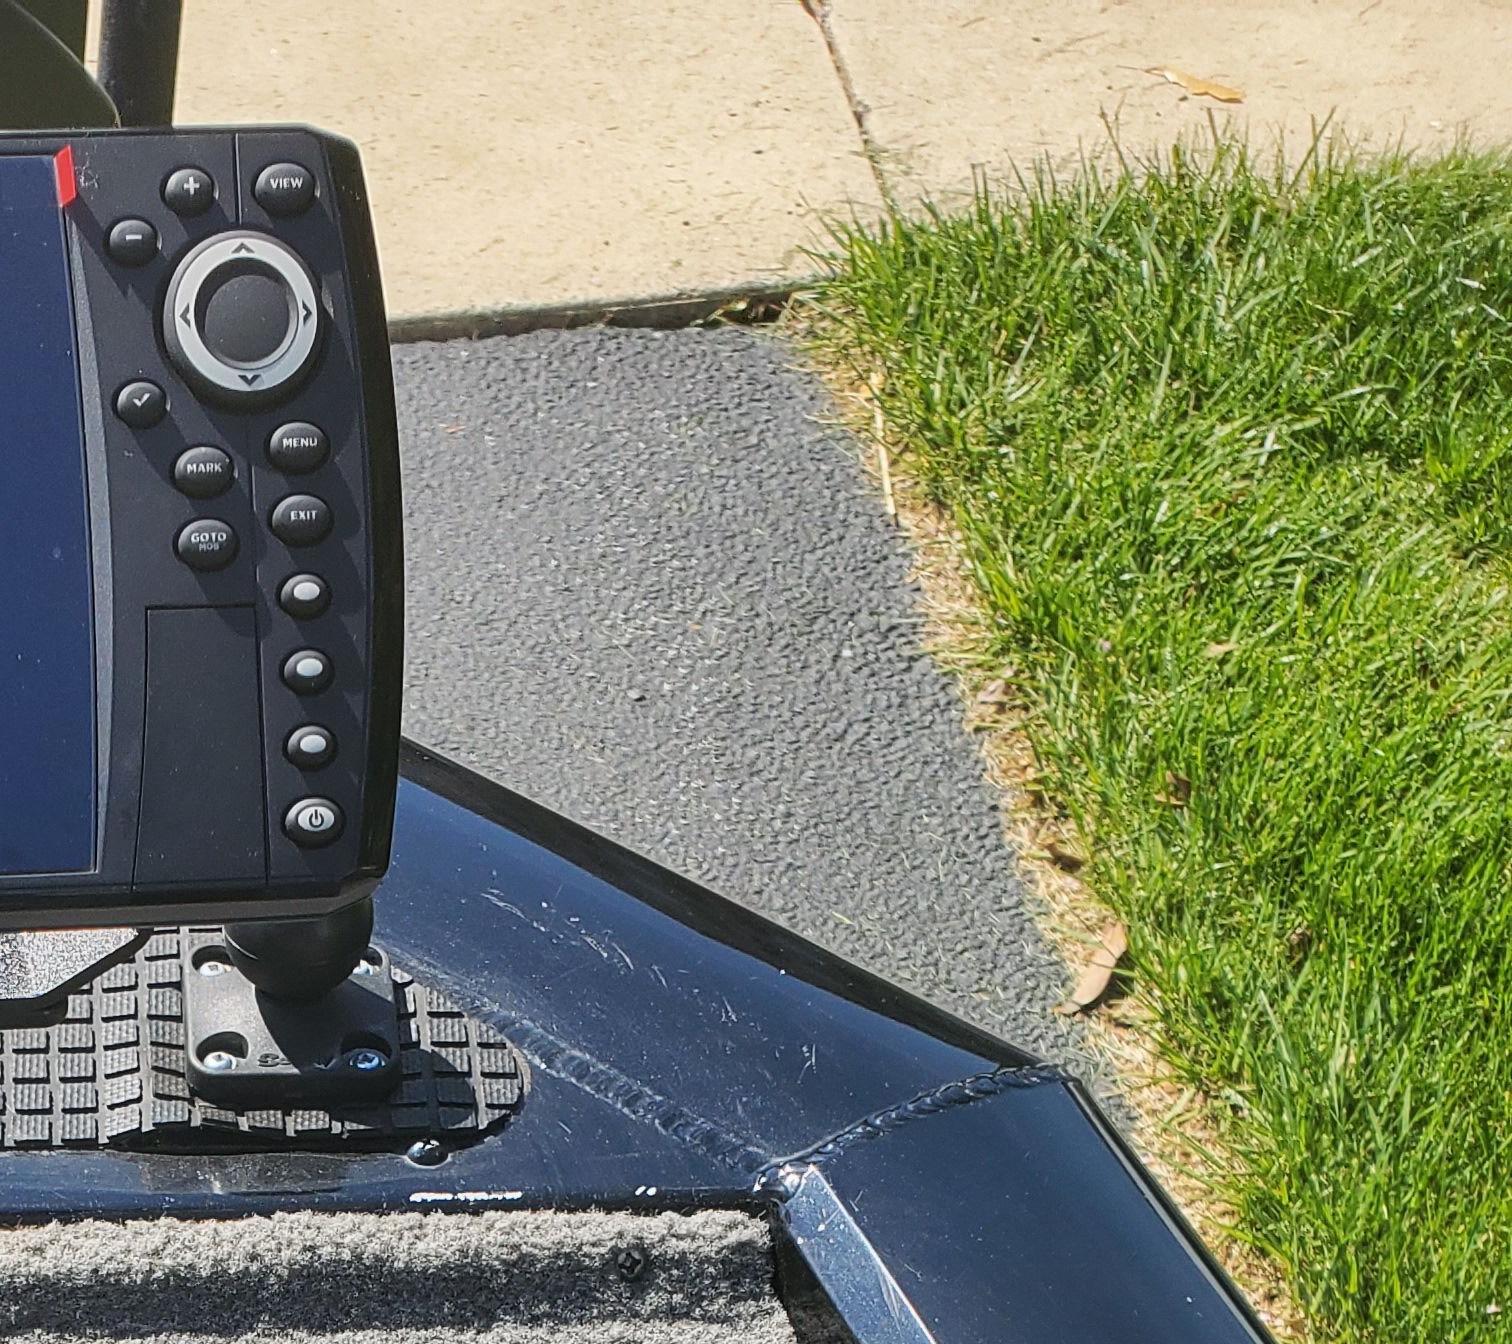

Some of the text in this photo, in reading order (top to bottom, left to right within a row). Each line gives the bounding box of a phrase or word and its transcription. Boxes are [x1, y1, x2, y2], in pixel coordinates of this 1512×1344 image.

[270, 177, 303, 189] VIEW
[283, 437, 317, 449] MENU
[187, 462, 223, 474] MARK
[290, 510, 317, 521] EXIT
[198, 542, 220, 552] MOB
